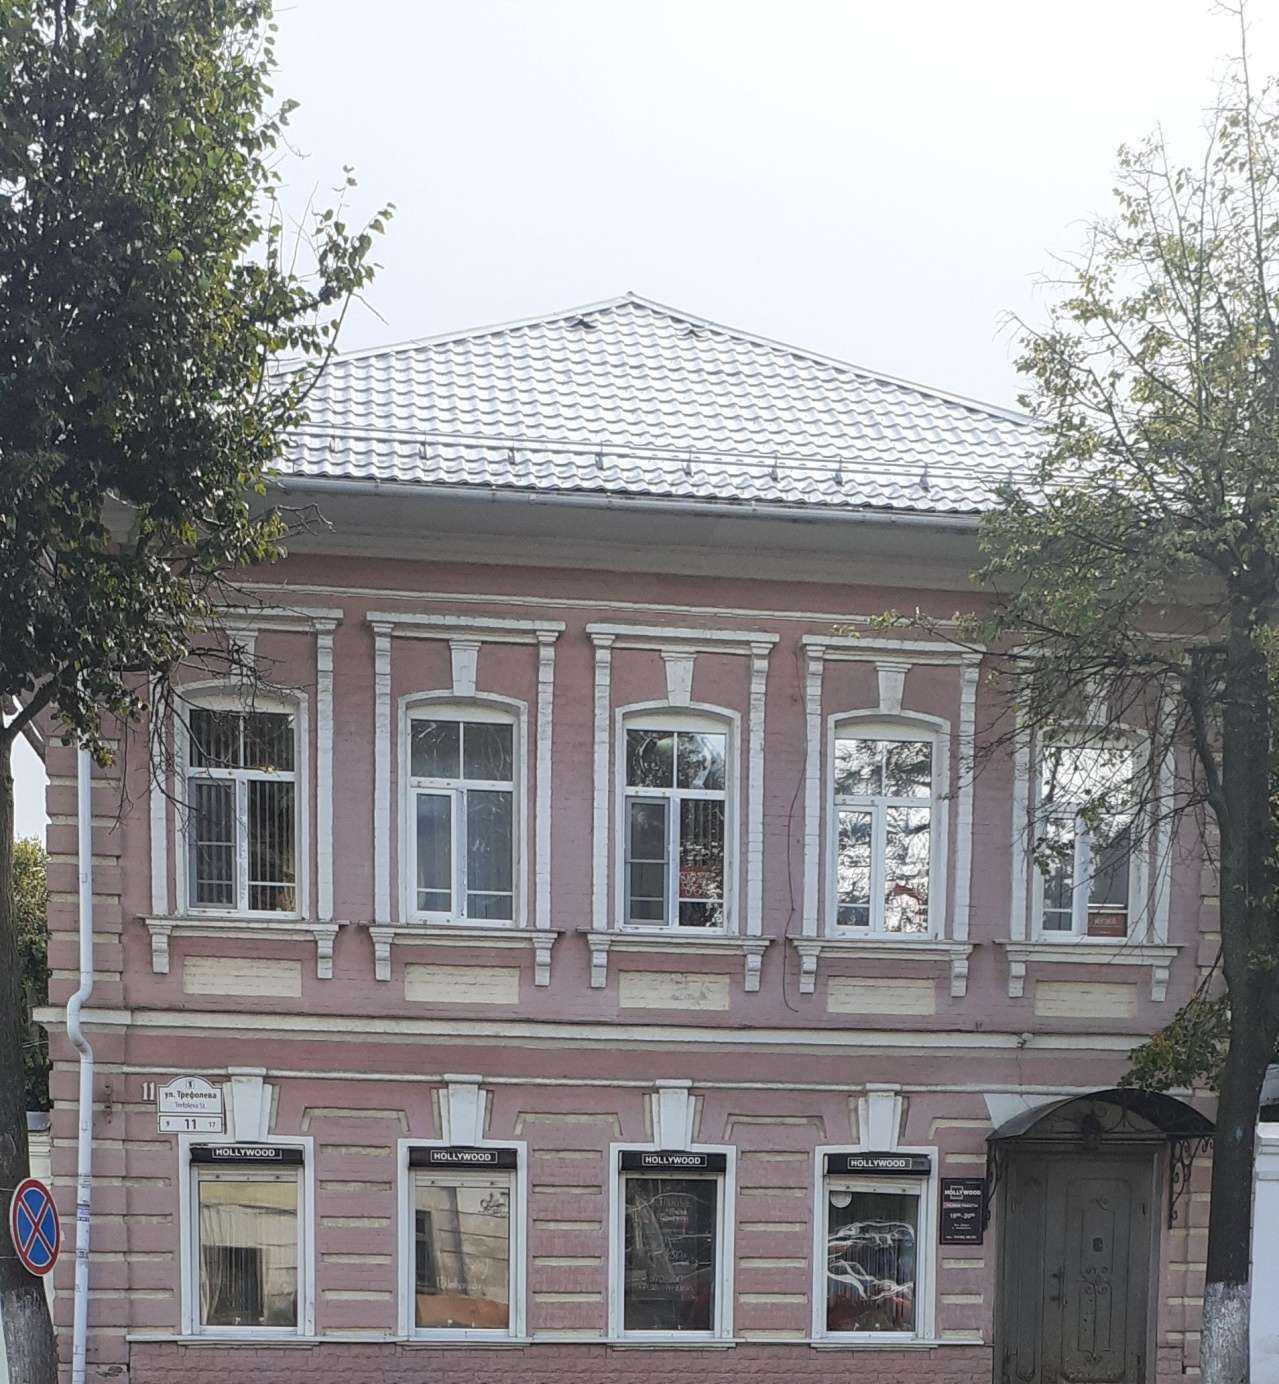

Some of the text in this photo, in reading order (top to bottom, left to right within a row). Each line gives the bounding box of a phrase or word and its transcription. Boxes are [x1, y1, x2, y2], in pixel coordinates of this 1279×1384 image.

[142, 1082, 156, 1100] 11
[177, 1090, 217, 1100] Трефолева
[184, 1118, 197, 1130] 11
[215, 1148, 276, 1157] HOLLYWOOD
[434, 1152, 491, 1161] HOLLYWOOD
[645, 1157, 701, 1165] HOLLYWOOD
[851, 1159, 906, 1167] HOLLYWOOD
